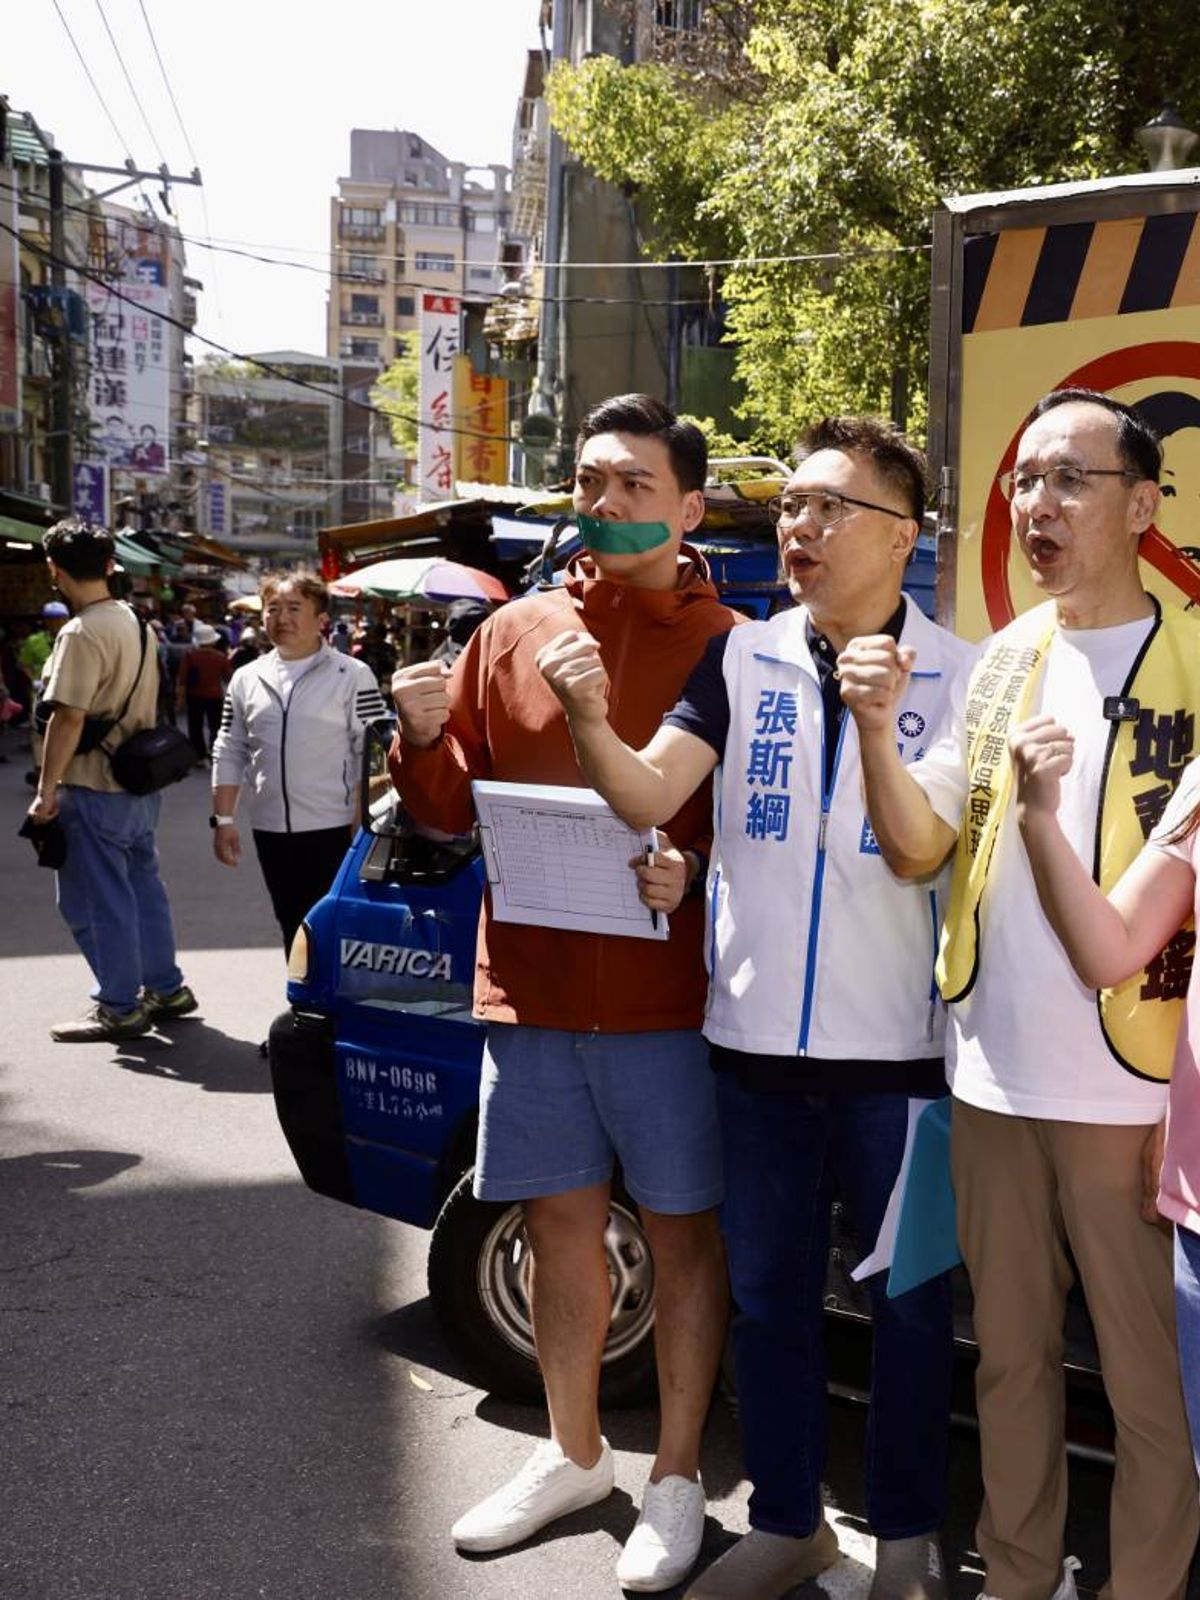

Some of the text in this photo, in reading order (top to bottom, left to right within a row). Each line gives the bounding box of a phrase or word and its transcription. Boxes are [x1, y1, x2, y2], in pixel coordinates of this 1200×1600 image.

[745, 690, 798, 842] 張斯綱
[340, 938, 452, 982] VARICA
